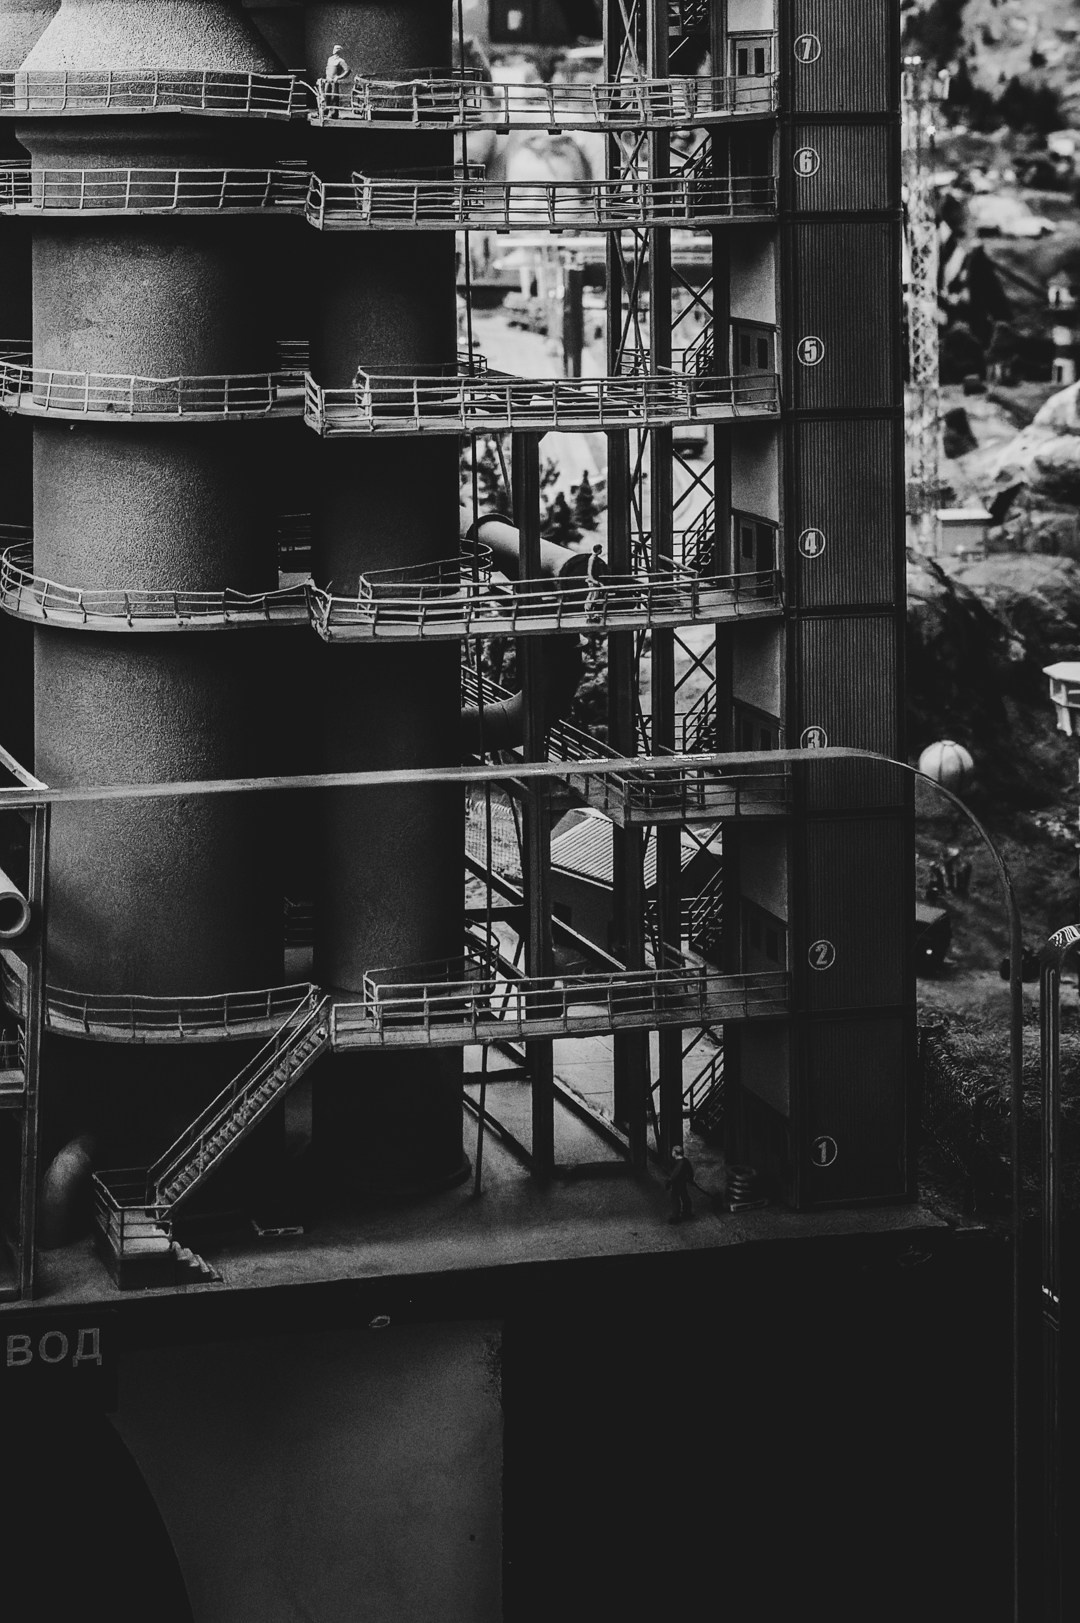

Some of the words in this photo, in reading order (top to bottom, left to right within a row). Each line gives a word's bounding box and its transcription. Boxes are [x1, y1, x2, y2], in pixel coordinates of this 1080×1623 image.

[800, 37, 813, 61] 7
[798, 150, 813, 174] 6
[803, 339, 818, 362] 5
[803, 530, 818, 556] 4
[814, 943, 829, 965] 2
[817, 1140, 828, 1163] 1
